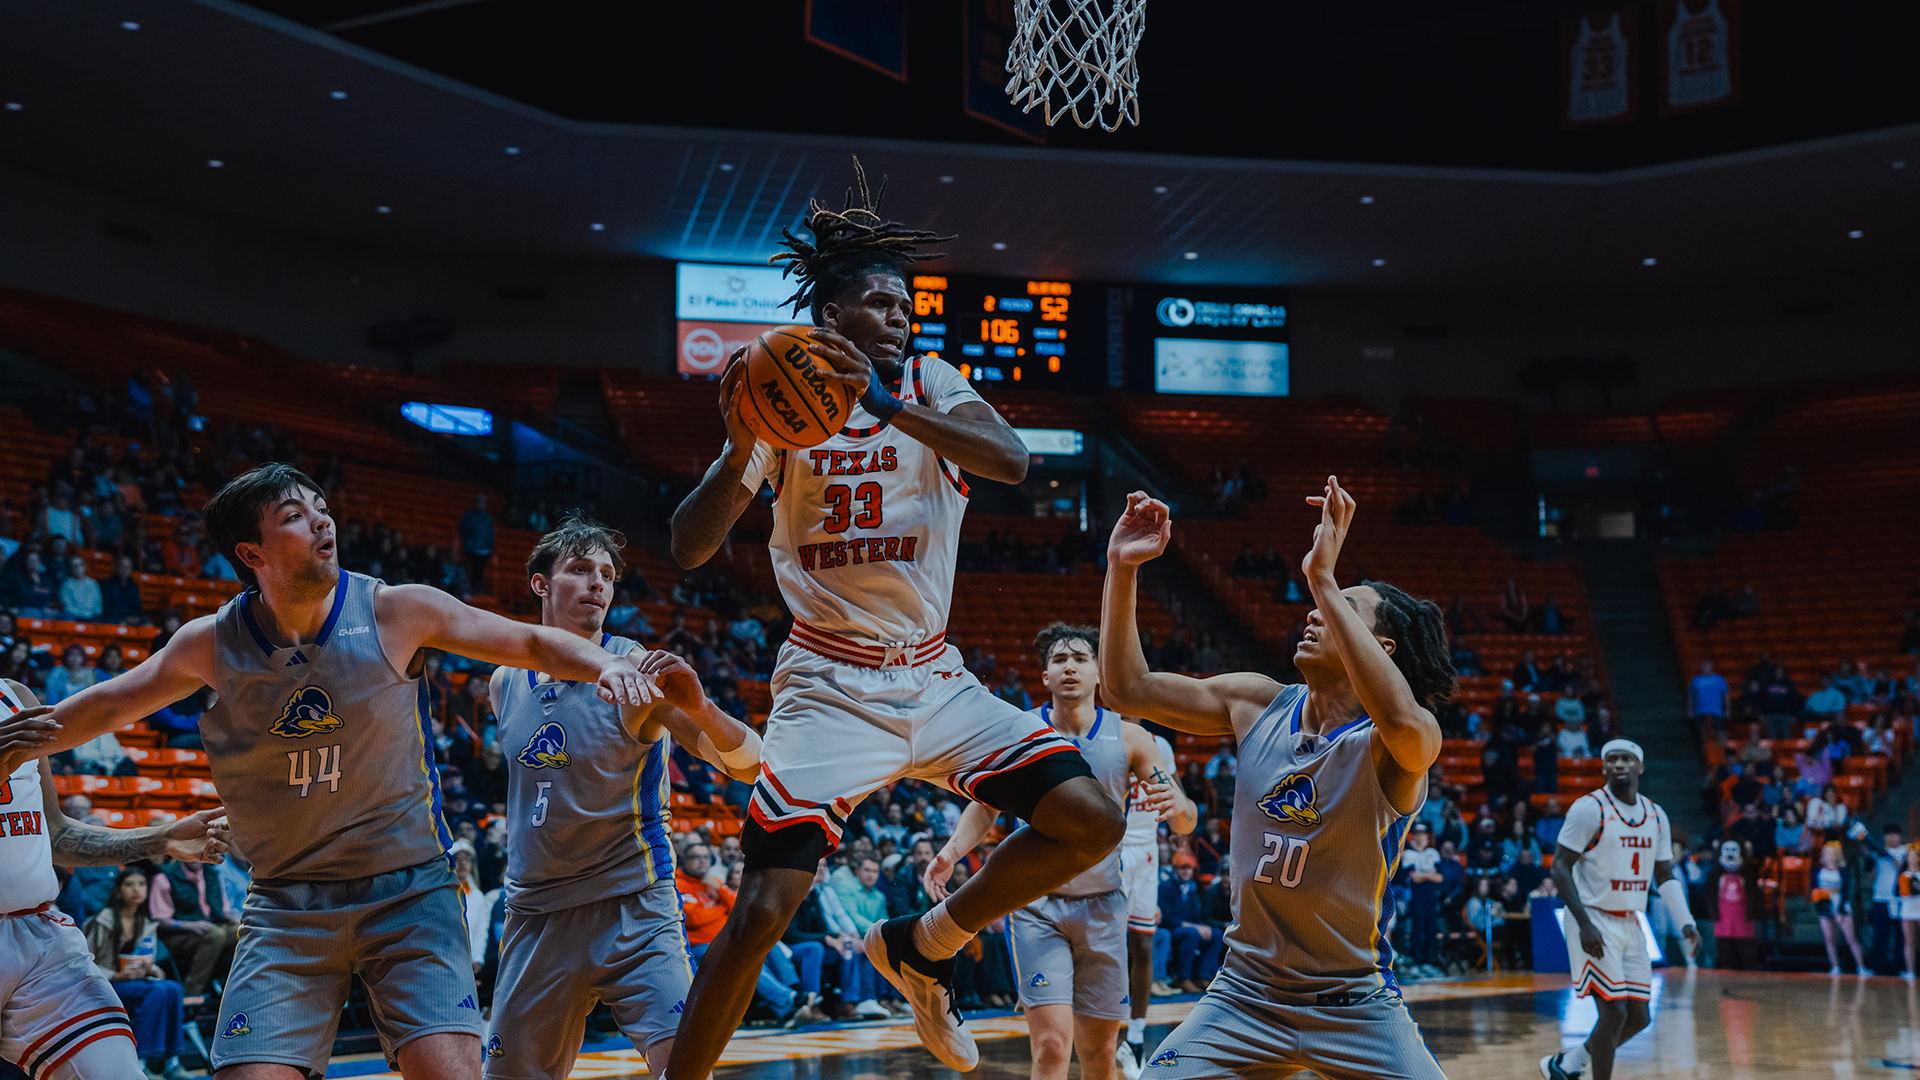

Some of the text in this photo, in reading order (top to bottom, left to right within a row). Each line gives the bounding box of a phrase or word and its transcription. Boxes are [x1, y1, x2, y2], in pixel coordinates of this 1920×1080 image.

[914, 291, 944, 316] 64
[1040, 296, 1069, 321] 52
[785, 343, 839, 421] Wilson
[761, 380, 808, 434] NCAA
[809, 446, 898, 476] TEXAS
[823, 481, 883, 534] 33
[798, 536, 918, 571] WESTERN
[286, 744, 342, 798] 44
[531, 780, 553, 828] 5
[1253, 831, 1311, 889] 20
[1620, 836, 1652, 848] TEXAS
[1631, 852, 1639, 875] 4
